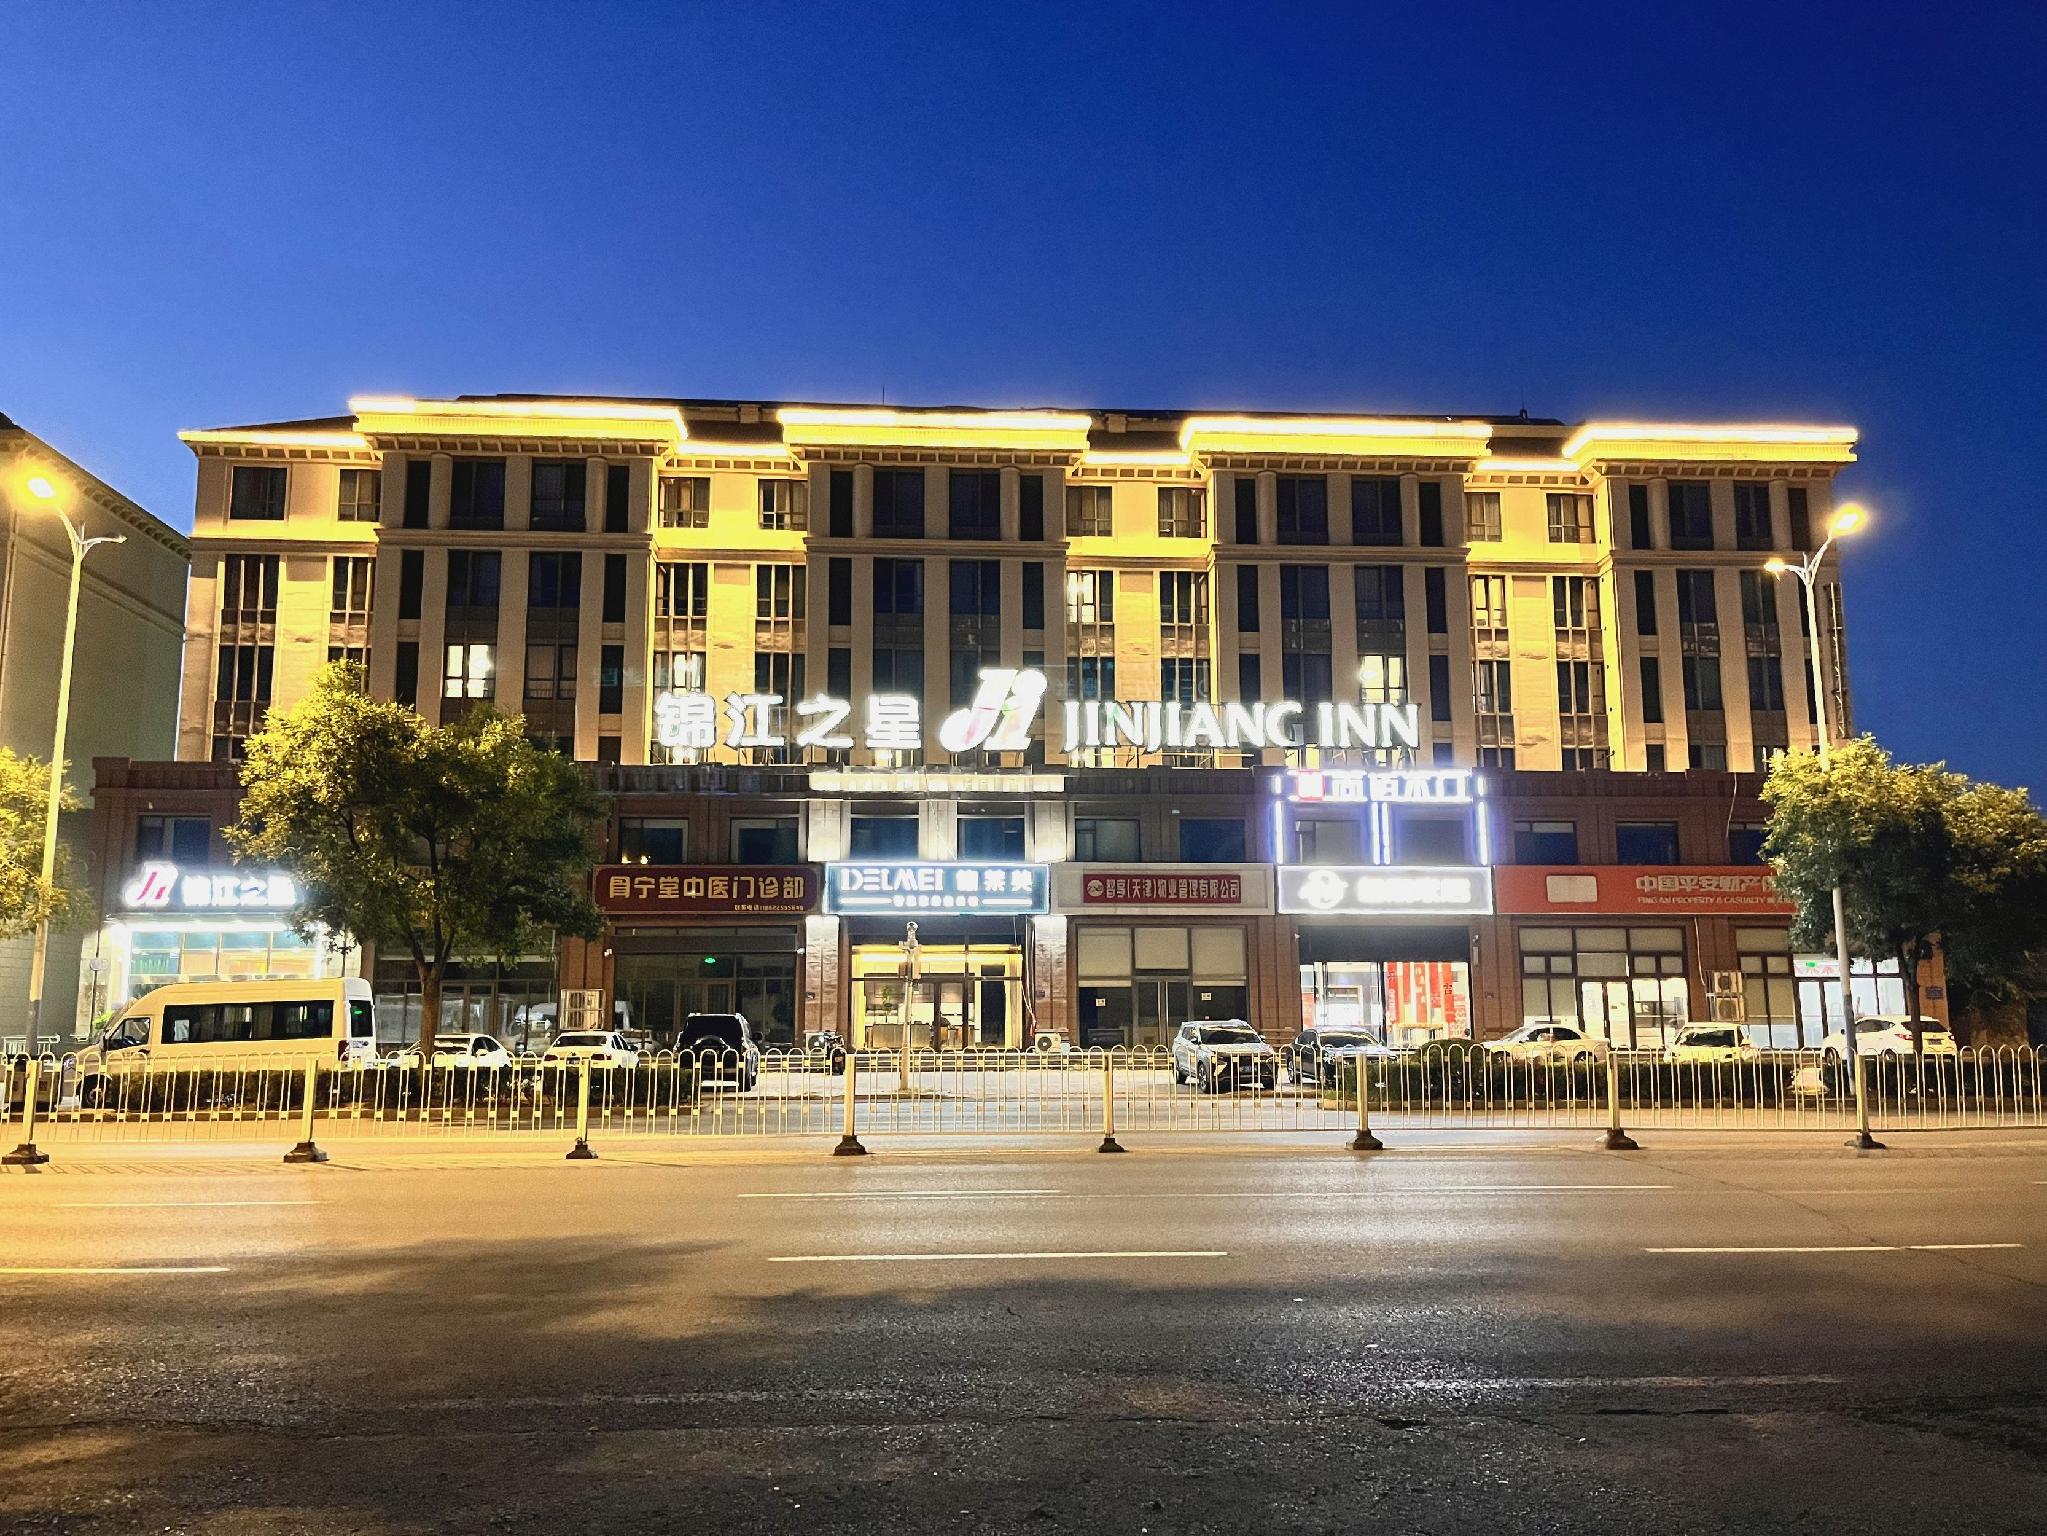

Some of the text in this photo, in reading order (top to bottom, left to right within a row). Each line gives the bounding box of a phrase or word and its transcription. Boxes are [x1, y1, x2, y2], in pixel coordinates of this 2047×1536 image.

[654, 691, 922, 750] 锦江之星
[1061, 701, 1422, 752] JINJIANG INN
[840, 868, 944, 891] DELMEI
[1658, 896, 1672, 905] AN
